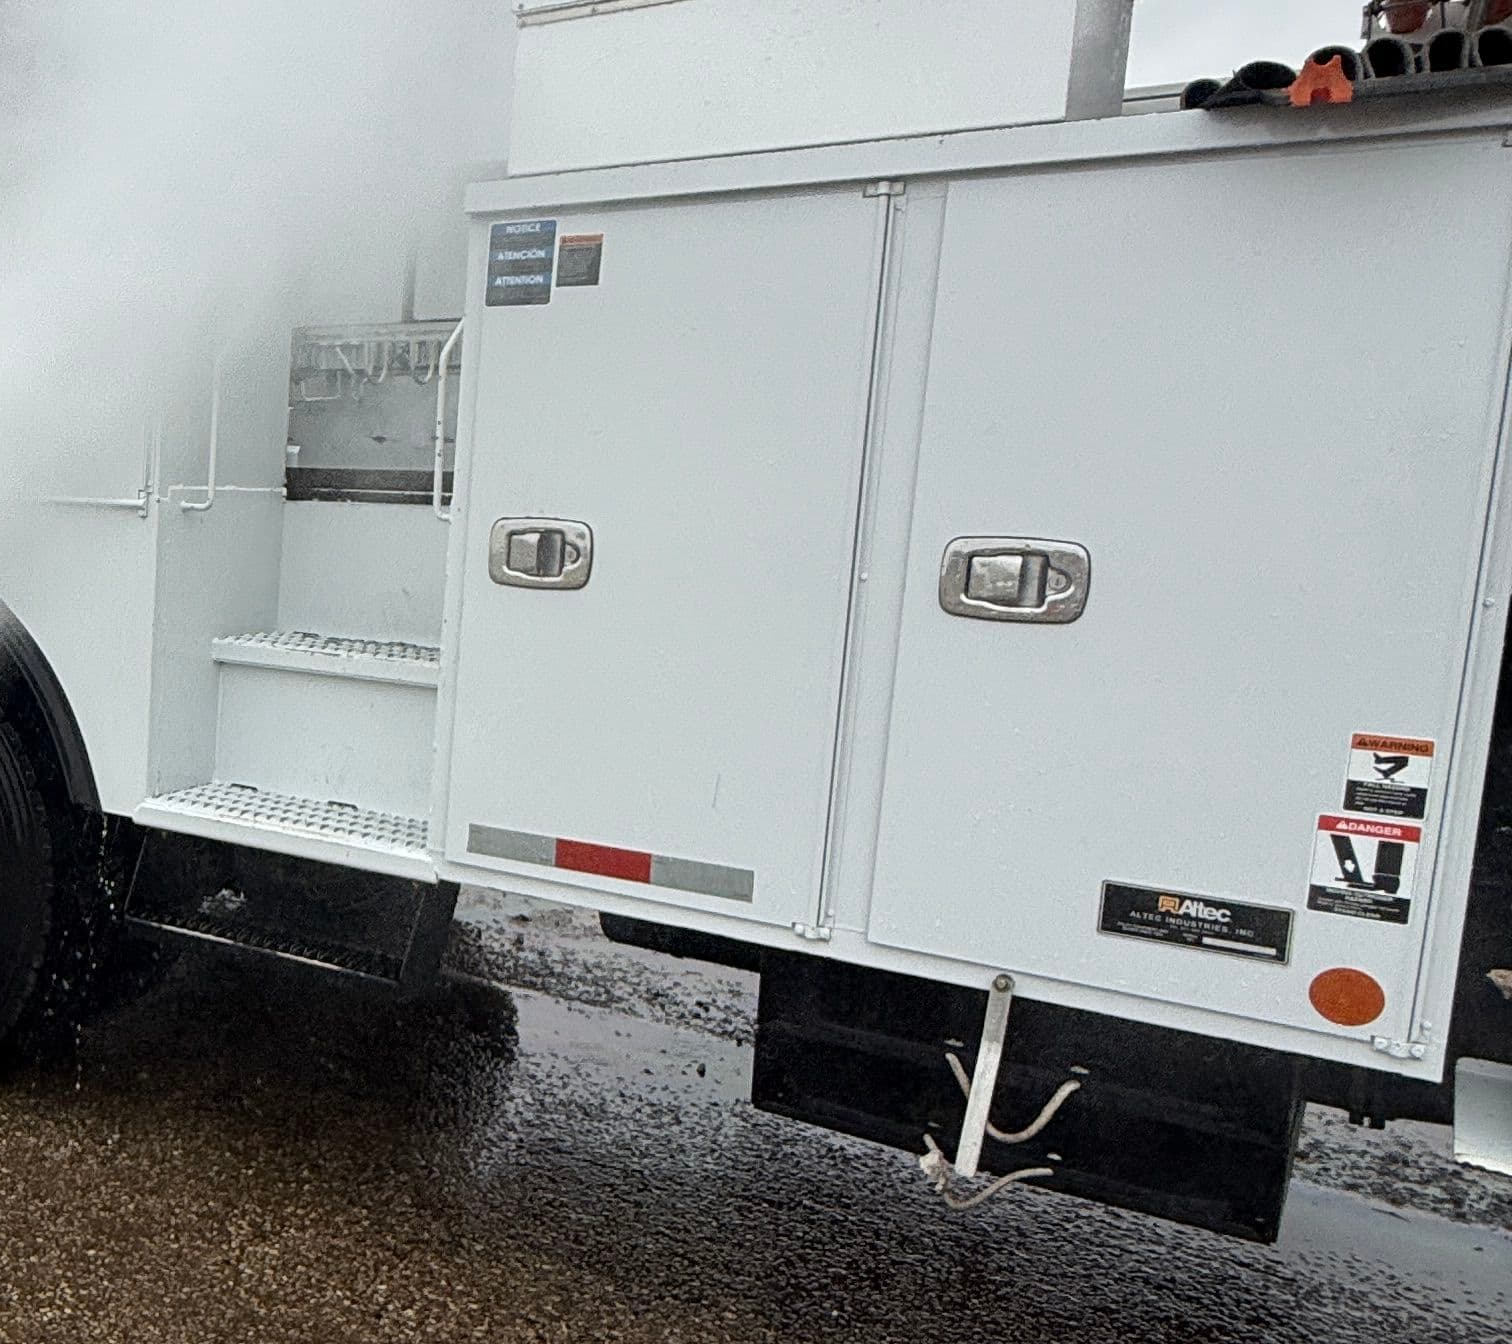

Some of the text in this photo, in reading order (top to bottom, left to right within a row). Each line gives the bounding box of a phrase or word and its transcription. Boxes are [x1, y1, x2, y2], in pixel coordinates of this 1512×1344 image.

[506, 223, 542, 234] NOTICE
[494, 274, 544, 288] ATTENTION
[1368, 739, 1429, 753] WARNING
[1348, 822, 1402, 837] DANGER
[1129, 910, 1162, 922] ALTEC
[1178, 899, 1232, 923] Altec
